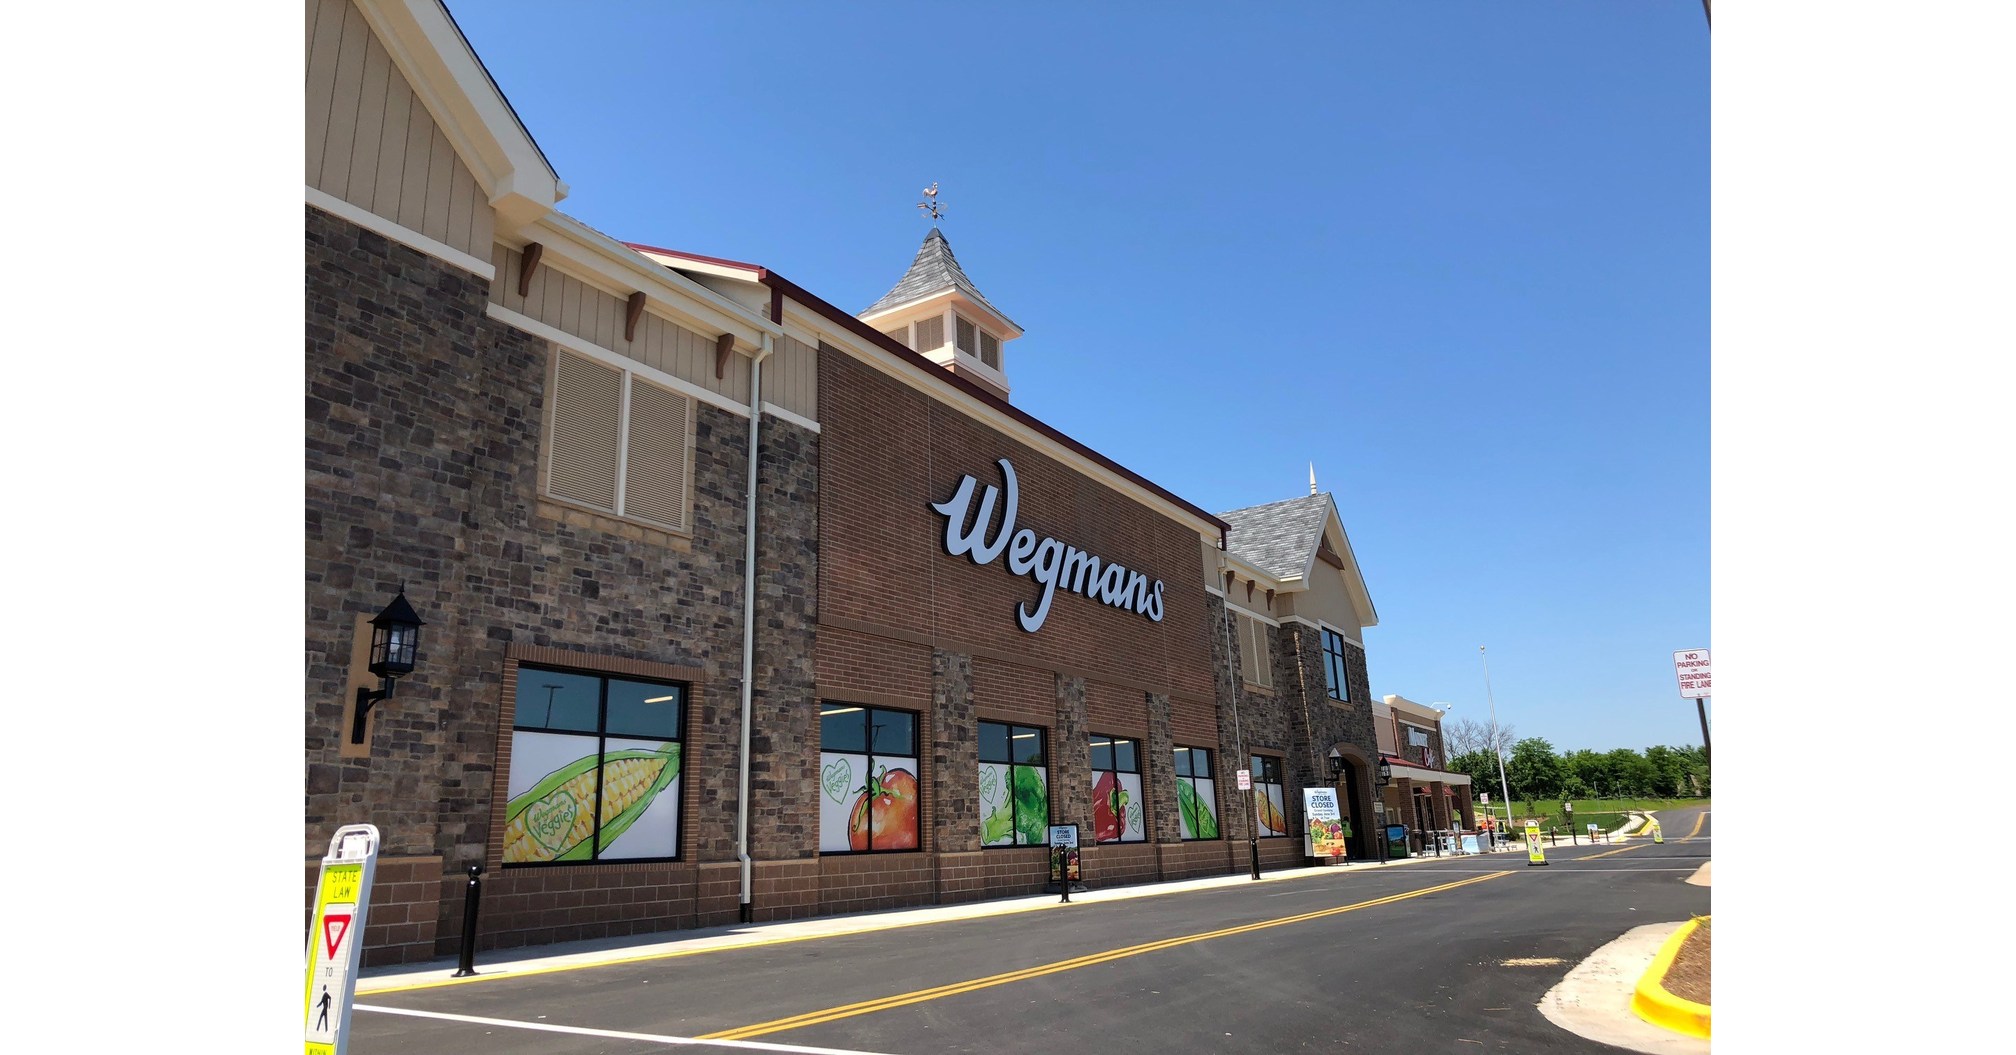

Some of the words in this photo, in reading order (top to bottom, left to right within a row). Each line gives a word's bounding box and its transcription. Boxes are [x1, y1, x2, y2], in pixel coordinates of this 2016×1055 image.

[926, 458, 1164, 633] Wegmans
[1677, 660, 1709, 668] PARKING
[1680, 672, 1711, 681] STANDING
[1681, 681, 1695, 689] FIRE
[533, 804, 573, 838] Veggies
[332, 871, 358, 883] STATE
[333, 887, 351, 899] LAW
[325, 967, 333, 977] TO
